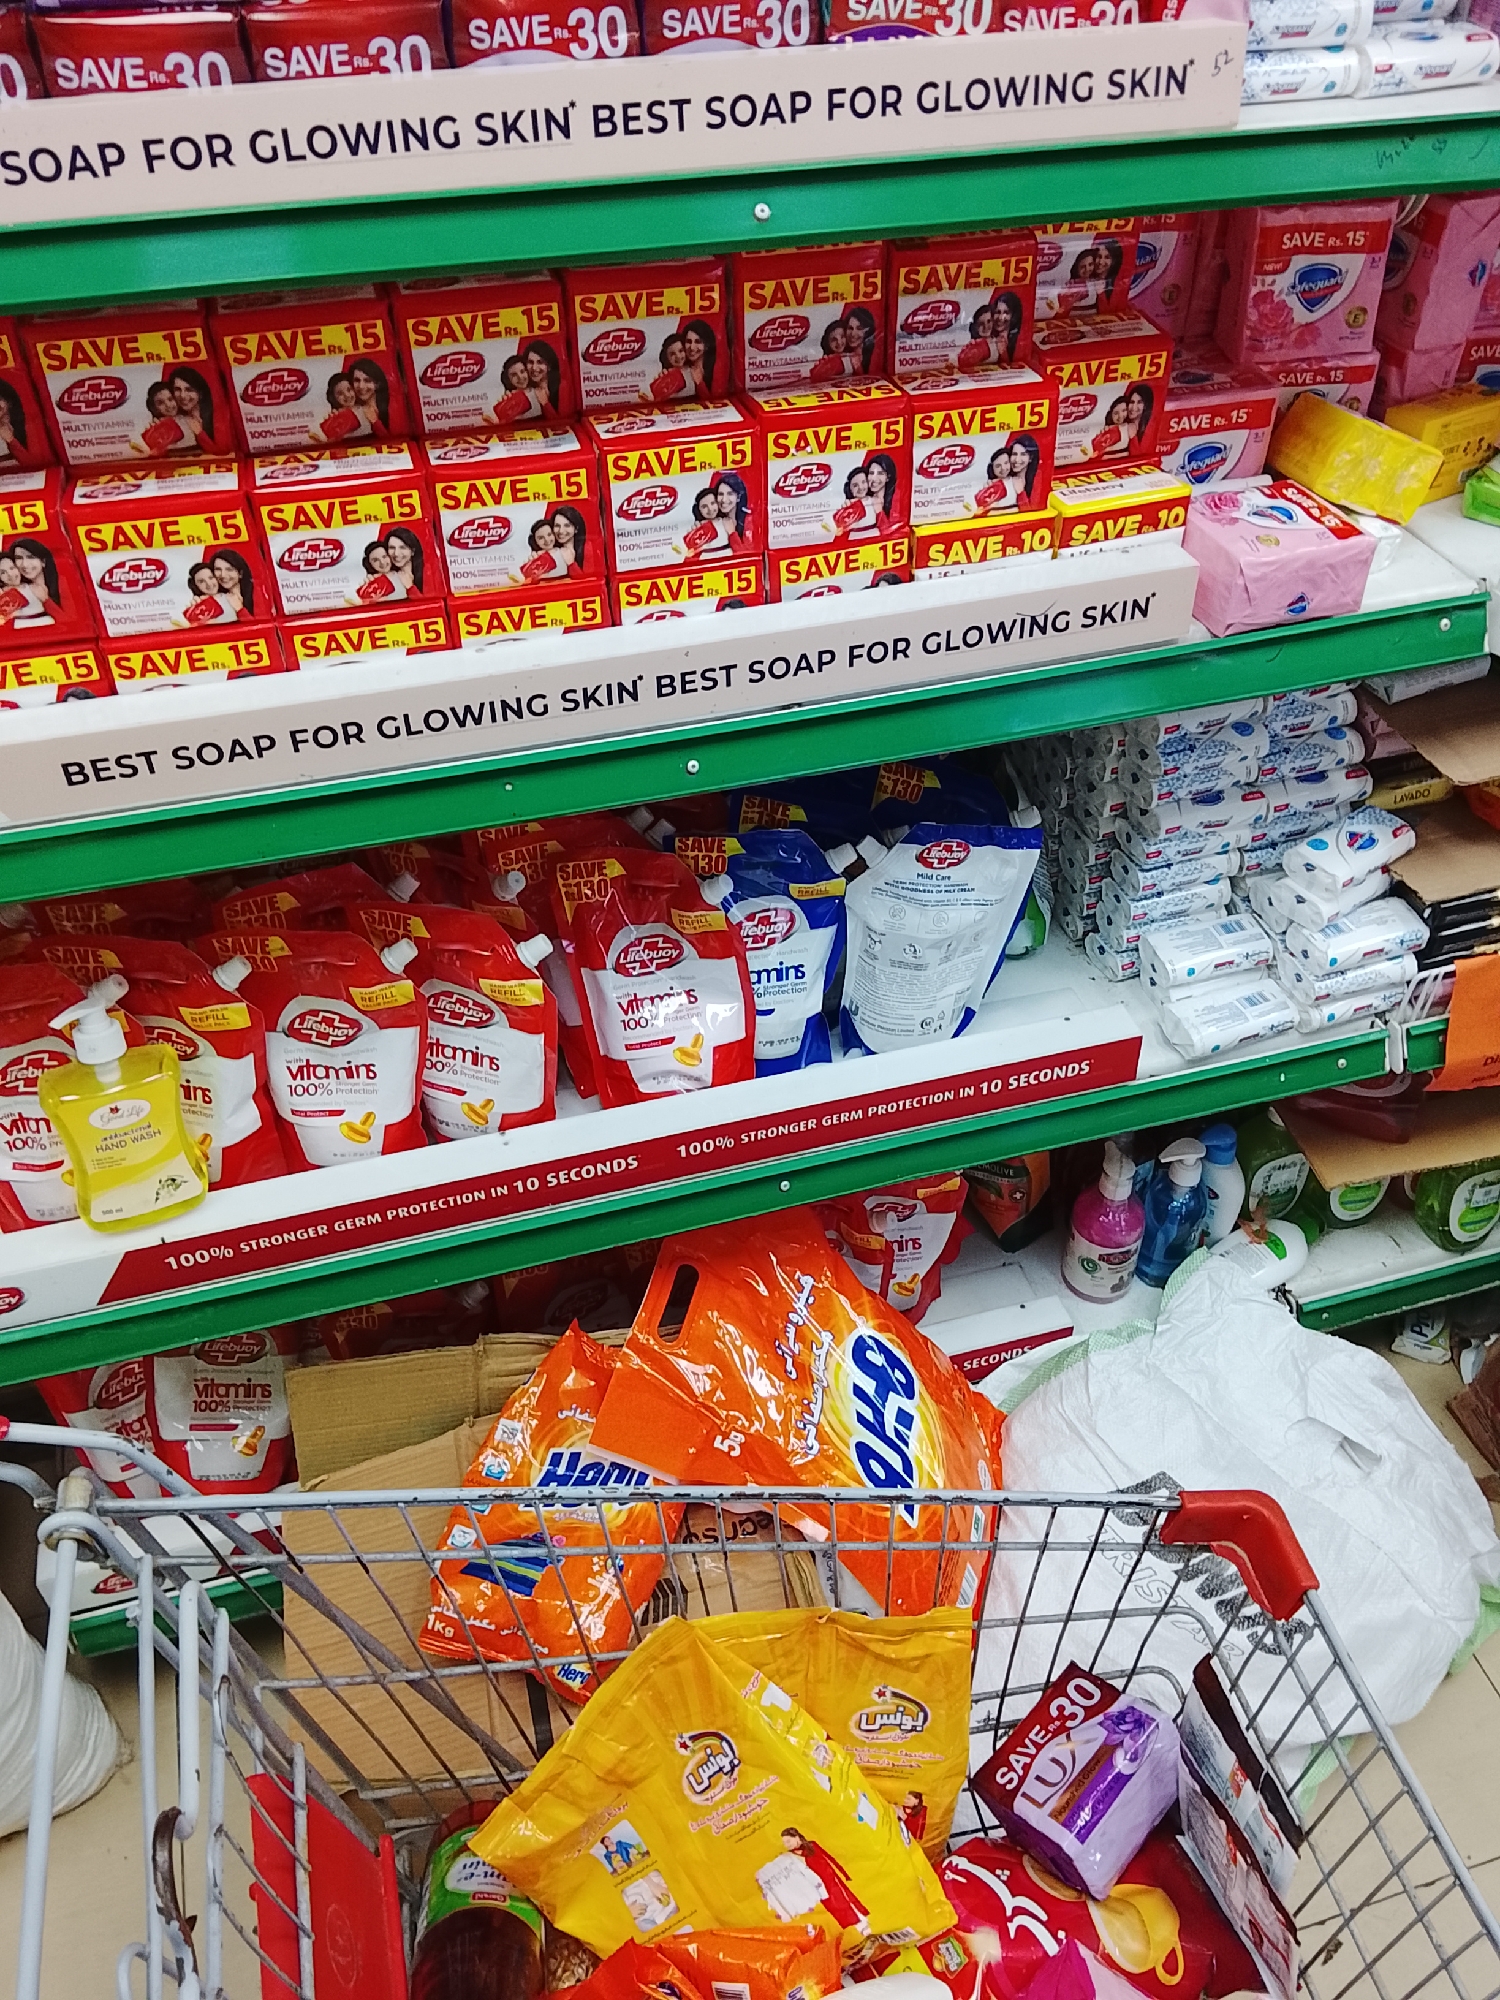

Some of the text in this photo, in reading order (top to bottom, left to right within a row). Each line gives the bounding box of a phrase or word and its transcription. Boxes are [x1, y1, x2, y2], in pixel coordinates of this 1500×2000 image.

[662, 4, 741, 38] SAVE
[847, 0, 923, 21] SAVE
[468, 15, 552, 50] SAVE
[567, 6, 628, 60] 30
[57, 57, 148, 91] SAVE
[264, 43, 350, 78] SAVE
[1, 142, 125, 186] SOAP
[143, 133, 237, 173] FOR
[250, 115, 461, 164] GLOWING
[593, 98, 692, 138] BEST
[705, 91, 812, 130] SOAP
[827, 84, 902, 121] FOR
[916, 71, 1094, 114] GLOWING
[1281, 232, 1326, 249] SAVE
[749, 277, 830, 310] SAVE
[902, 262, 982, 295] SAVE
[1286, 267, 1349, 298] Safeguard
[578, 290, 664, 323] SAVE
[412, 311, 502, 347] SAVE
[755, 326, 806, 343] Lifebuoy
[42, 336, 142, 371] SAVE
[229, 329, 326, 365] SAVE
[589, 339, 641, 355] Lifebuoy
[426, 362, 484, 379] Lifebuoy
[1050, 358, 1119, 388] SAVE
[1278, 371, 1314, 385] SAVE
[63, 386, 123, 405] Lifebuoy
[247, 379, 305, 397] Lifebuoy
[918, 402, 1045, 440] SAVE 15
[1169, 413, 1212, 432] SAVE
[772, 420, 903, 459] SAVE 15
[612, 439, 747, 482] SAVE 15
[923, 454, 972, 470] Lifebuoy
[1175, 443, 1232, 475] Safeguard
[442, 471, 584, 511] SAVE 15
[779, 473, 828, 489] Lifebuoy
[266, 493, 418, 533] SAVE 15
[622, 494, 674, 512] Lifebuoy
[84, 514, 243, 552] SAVE 15
[454, 526, 509, 542] Lifebuoy
[616, 523, 679, 539] MULTIVITAMINS
[1069, 515, 1142, 546] SAVE
[284, 547, 341, 564] Lifebuoy
[618, 542, 643, 552] 100%
[928, 536, 1004, 568] SAVE
[105, 566, 165, 584] Lifebuoy
[785, 554, 860, 584] SAVE
[625, 575, 704, 607] SAVE
[464, 606, 549, 637] SAVE
[301, 628, 390, 658] SAVE
[115, 648, 208, 681] SAVE
[61, 750, 158, 788] BEST
[171, 733, 277, 770] SOAP
[290, 722, 364, 753] FOR
[377, 692, 550, 741] GLOWING
[655, 663, 738, 698] BEST
[748, 648, 836, 684] SOAP
[848, 636, 911, 669] FOR
[921, 610, 1072, 655] GLOWING
[676, 837, 727, 853] SAVE
[558, 861, 608, 881] SAVE
[917, 873, 952, 881] Mild Care
[619, 946, 681, 965] Lifebuoy
[360, 991, 397, 1004] REFILL
[428, 998, 491, 1020] Lifebuoy
[294, 1018, 358, 1037] Lifebuoy
[286, 1059, 377, 1081] vitamins
[287, 1083, 333, 1097] 100%
[677, 1135, 735, 1159] 100%
[740, 1119, 817, 1144] STRONGER
[821, 1109, 863, 1127] GERM
[867, 1090, 955, 1118] PROTECTION
[959, 1087, 975, 1098] IN
[980, 1079, 1003, 1096] 10
[96, 1128, 162, 1154] HAND WASH
[164, 1244, 235, 1271] 100%
[240, 1222, 330, 1254] STRONGER
[333, 1212, 383, 1233] GERM
[386, 1190, 487, 1221] PROTECTION
[491, 1186, 509, 1197] IN
[513, 1176, 541, 1195] 10
[204, 1341, 262, 1355] Lifebuoy
[194, 1378, 273, 1399] vitamins
[192, 1400, 231, 1413] 100%
[995, 1723, 1052, 1791] SAVE
[1049, 1677, 1102, 1728] 30
[1020, 1732, 1099, 1810] LUX
